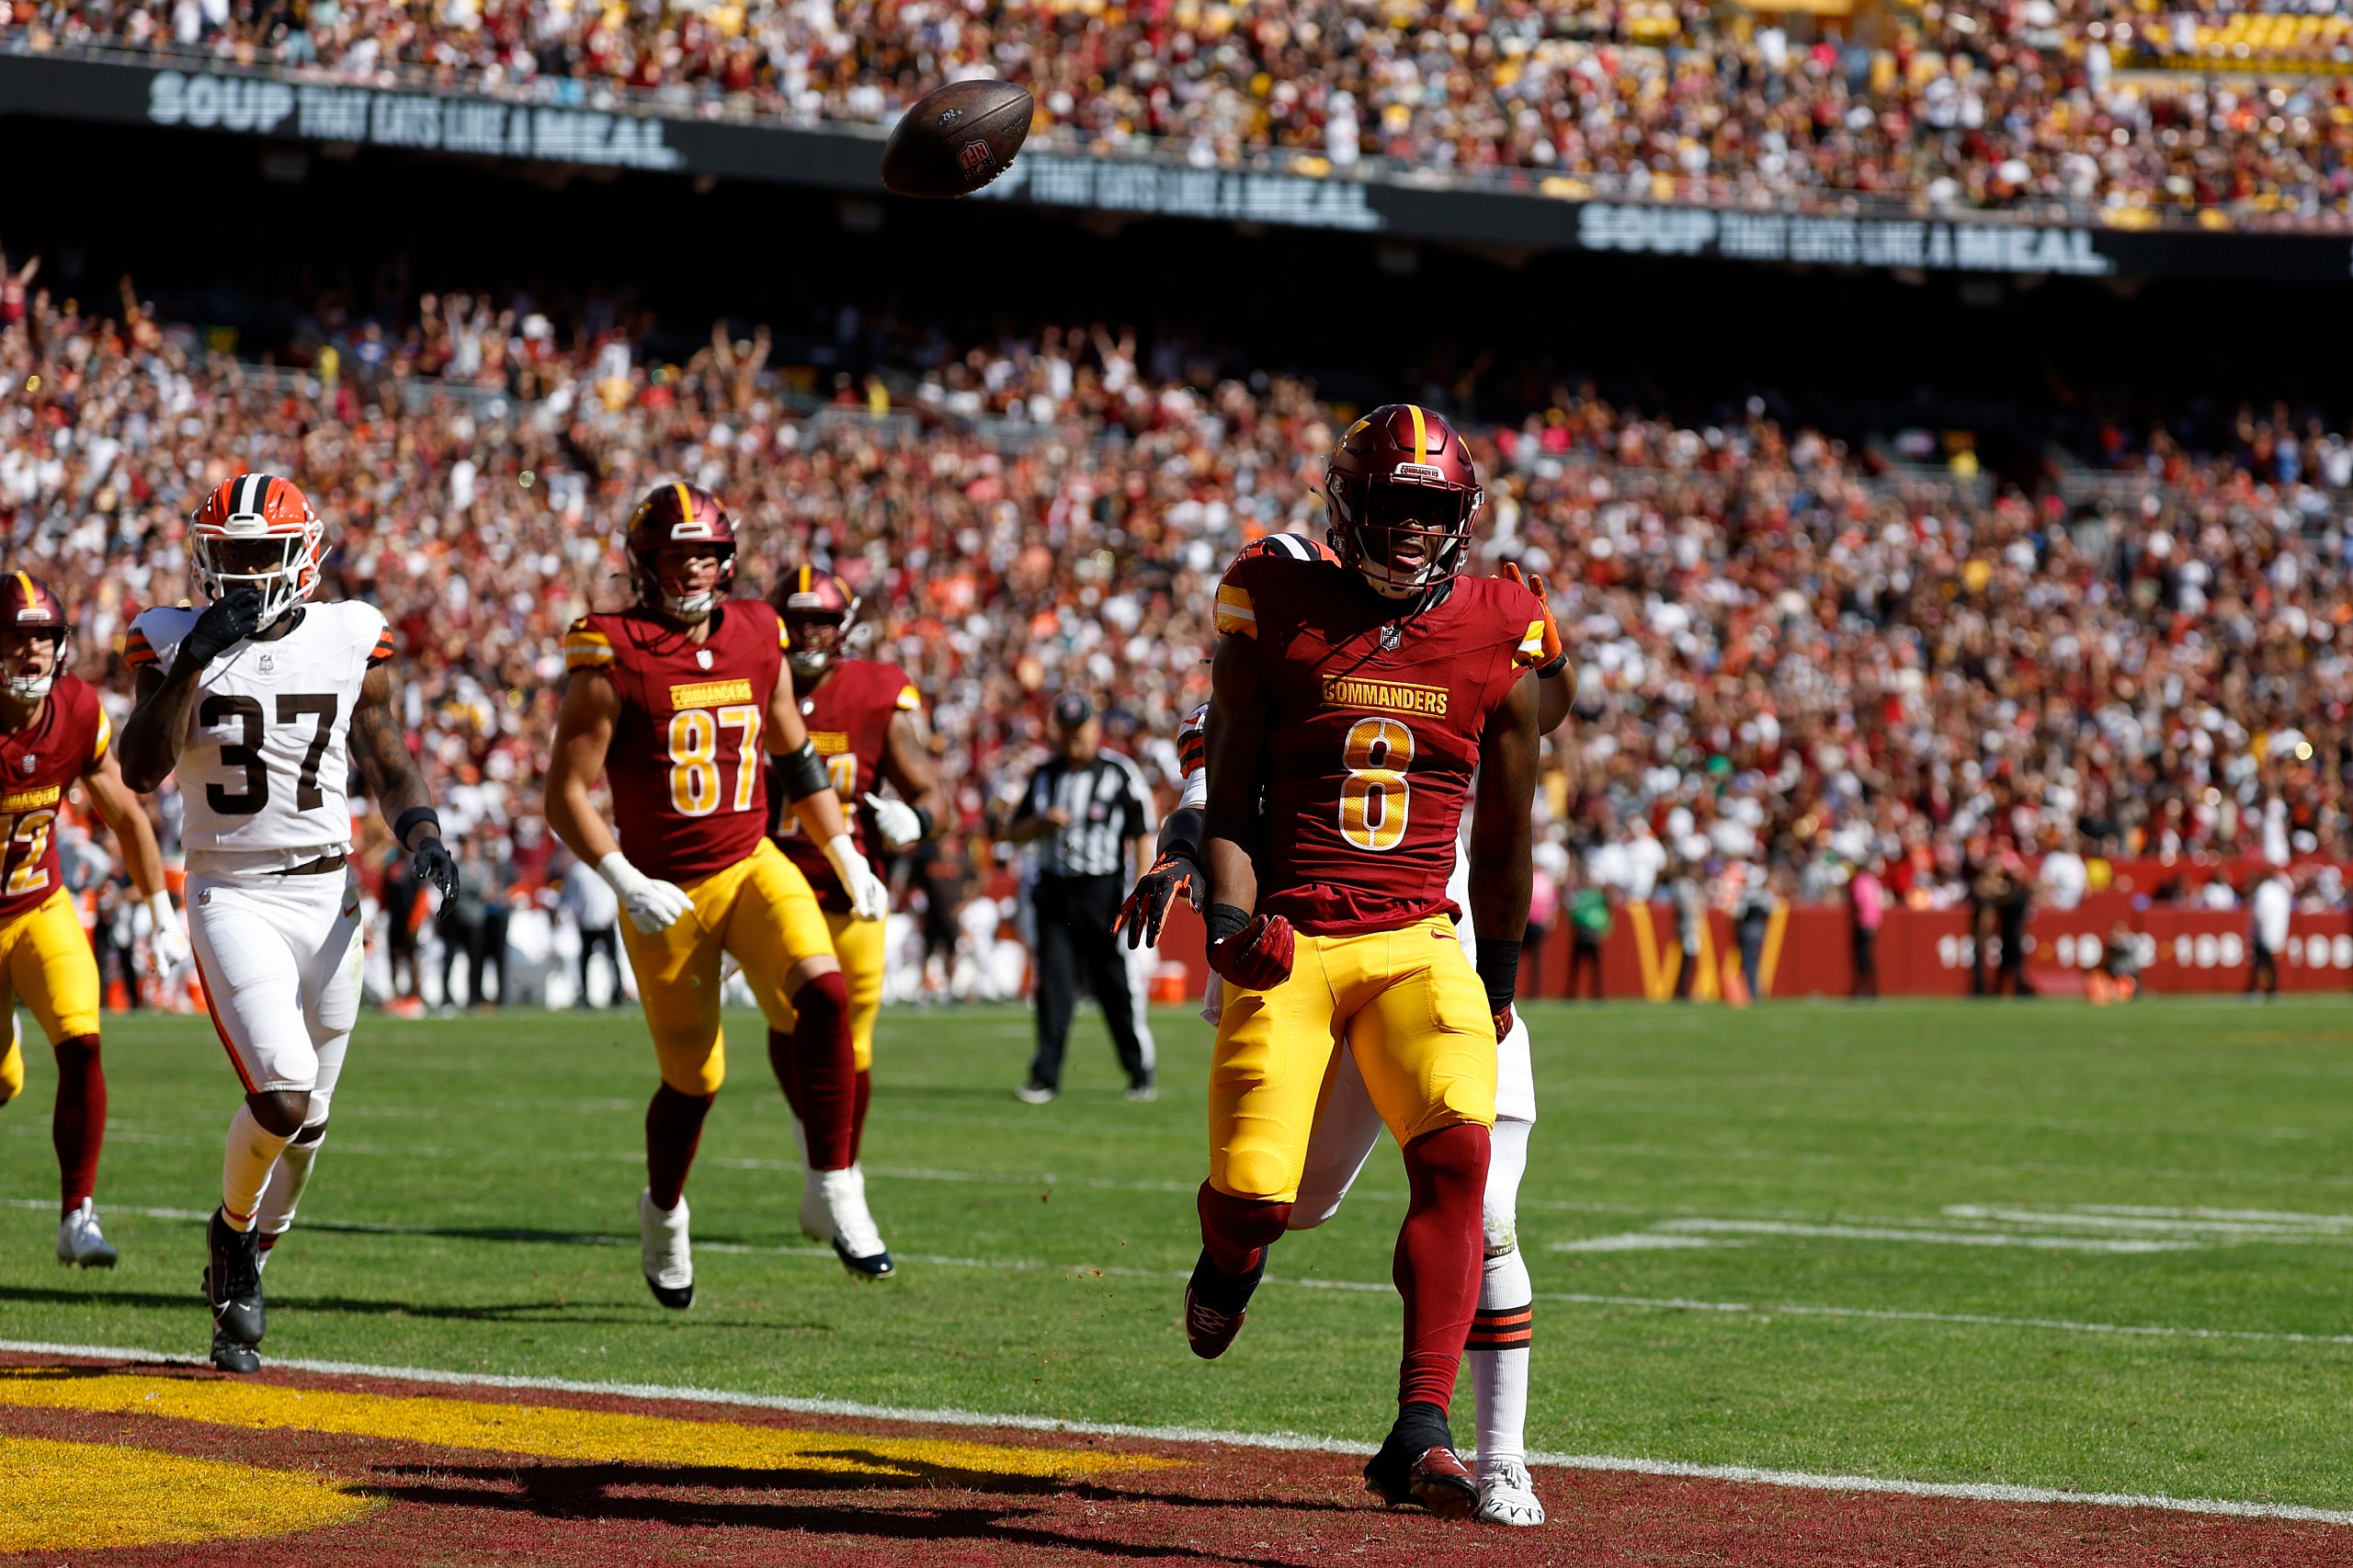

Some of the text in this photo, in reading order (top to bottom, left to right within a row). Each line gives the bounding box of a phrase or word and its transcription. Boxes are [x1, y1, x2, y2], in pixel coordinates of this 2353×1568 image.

[146, 69, 293, 133] SOUP
[506, 104, 530, 160] A
[961, 142, 990, 166] NFL
[1575, 201, 1717, 255] SOUP
[1400, 466, 1439, 477] COMMANDERS
[1323, 679, 1449, 714] COMMANDERS
[199, 693, 338, 815] 37
[667, 704, 762, 817] 87
[1339, 717, 1415, 851] 8
